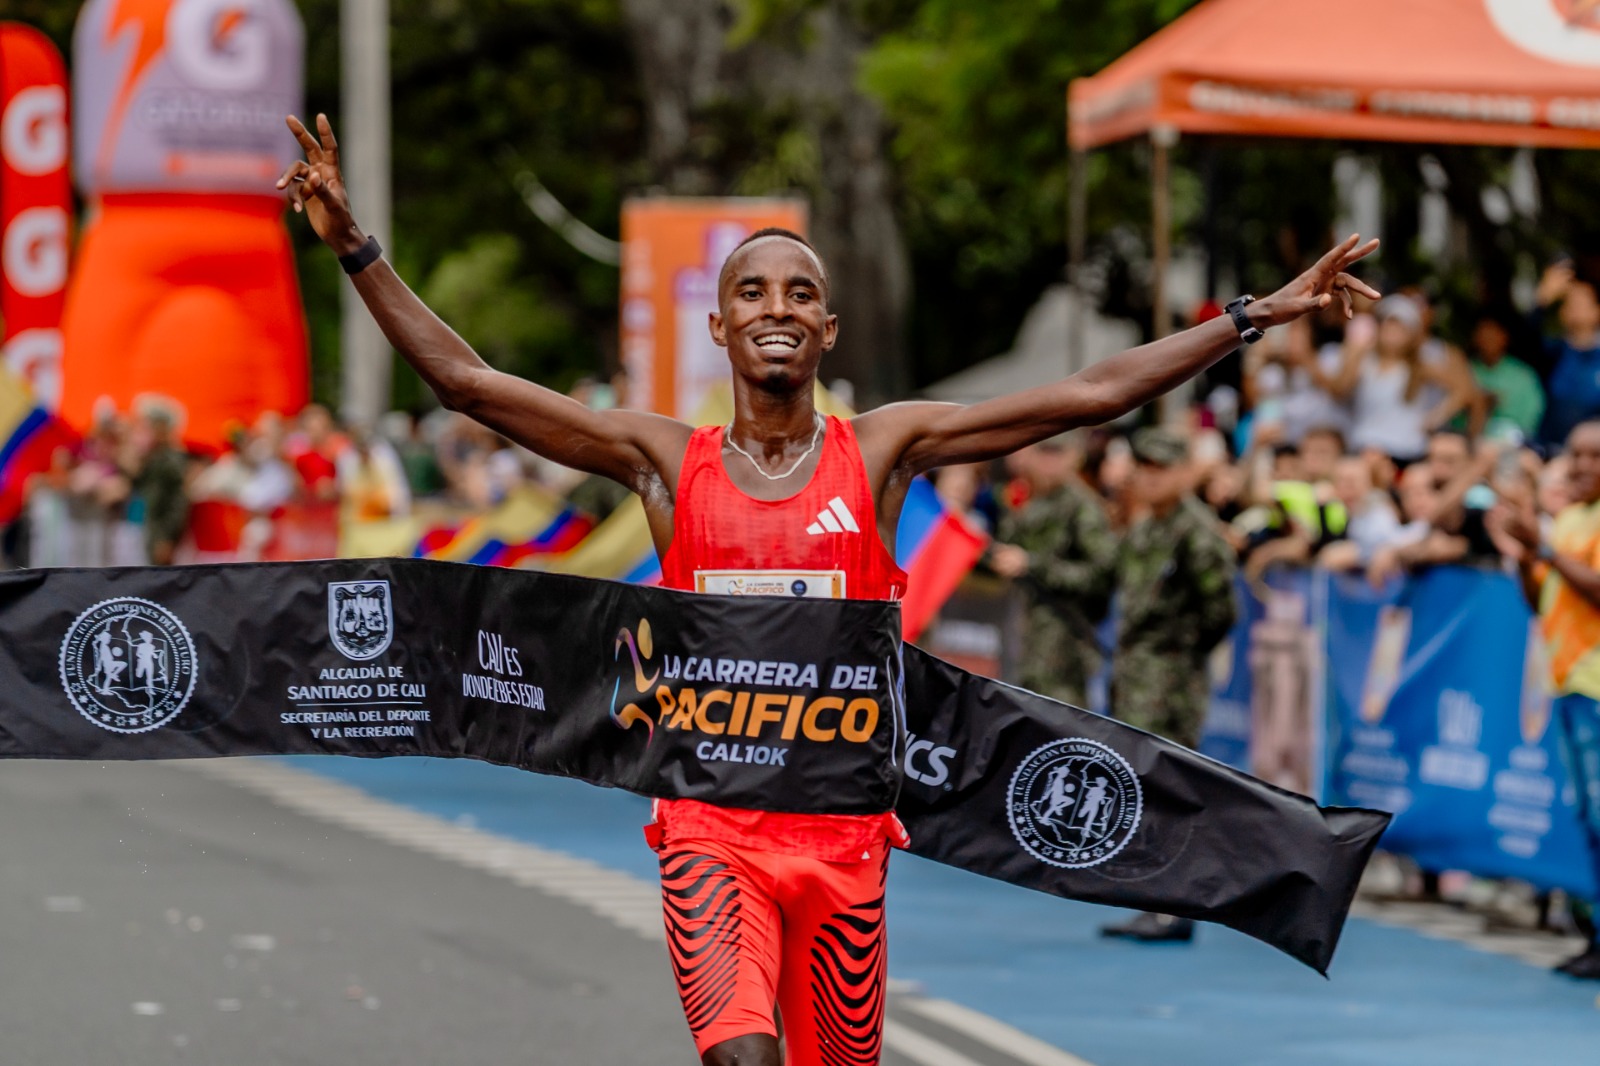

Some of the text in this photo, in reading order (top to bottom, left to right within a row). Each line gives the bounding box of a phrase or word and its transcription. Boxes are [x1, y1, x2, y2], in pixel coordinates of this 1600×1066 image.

[158, 616, 176, 634] DEL
[173, 631, 191, 675] FUTURO
[319, 663, 404, 680] ALCALDÍA DE
[503, 647, 523, 677] ES
[663, 654, 878, 690] LA CARRERA DEL
[287, 683, 426, 700] SANTIAGO DE CALI
[518, 683, 546, 711] ESTAR
[280, 708, 431, 724] SECRETARÍA DEL DEPORTE
[655, 684, 879, 743] PACIFICO
[310, 722, 415, 739] Y LA RECREACIÓN
